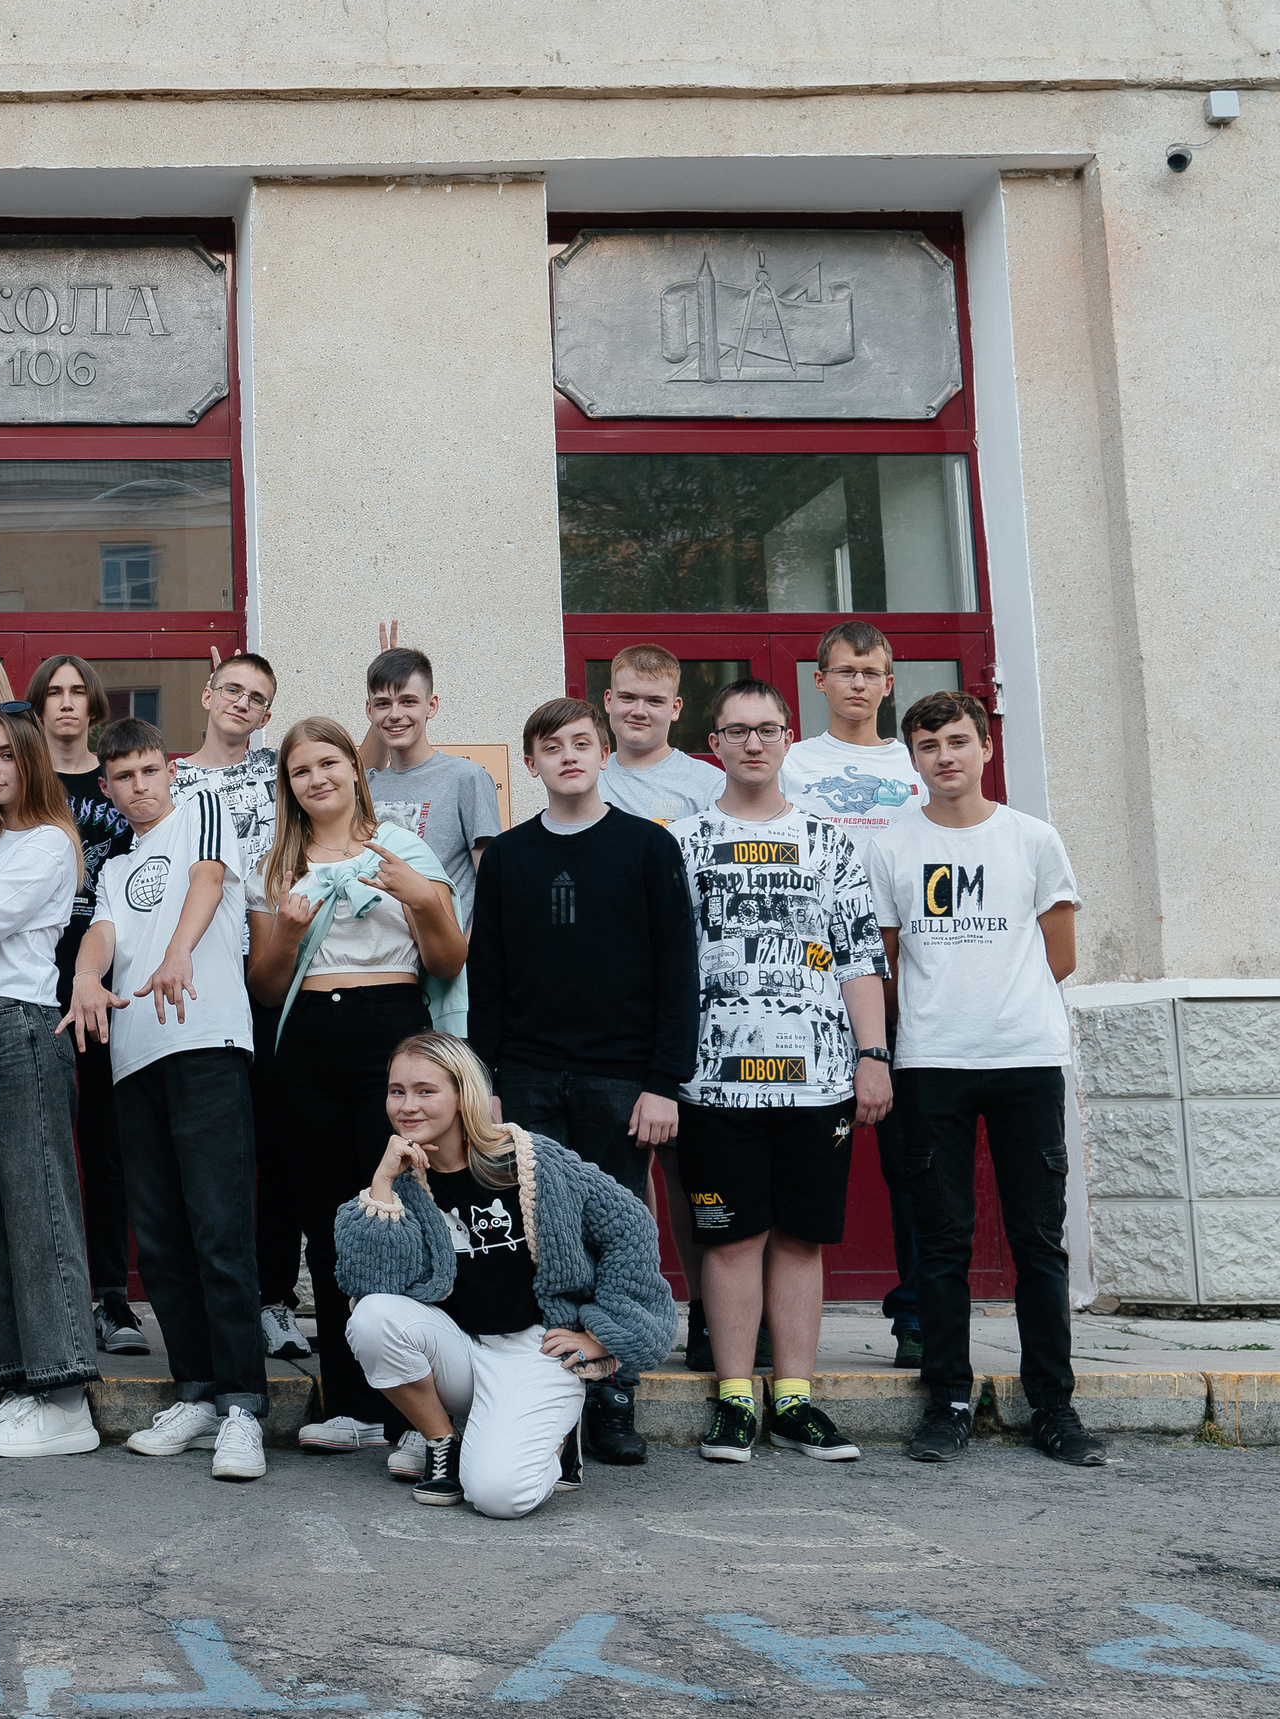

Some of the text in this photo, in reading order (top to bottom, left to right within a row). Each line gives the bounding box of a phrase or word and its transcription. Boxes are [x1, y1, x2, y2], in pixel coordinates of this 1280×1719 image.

[417, 822, 426, 838] WO
[844, 818, 890, 826] RESPONSIBLE
[734, 843, 778, 862] IDBOY
[911, 916, 1008, 934] BULL POWER
[756, 937, 804, 965] BAND
[740, 1059, 786, 1081] IDBOY
[691, 1193, 723, 1204] NASA
